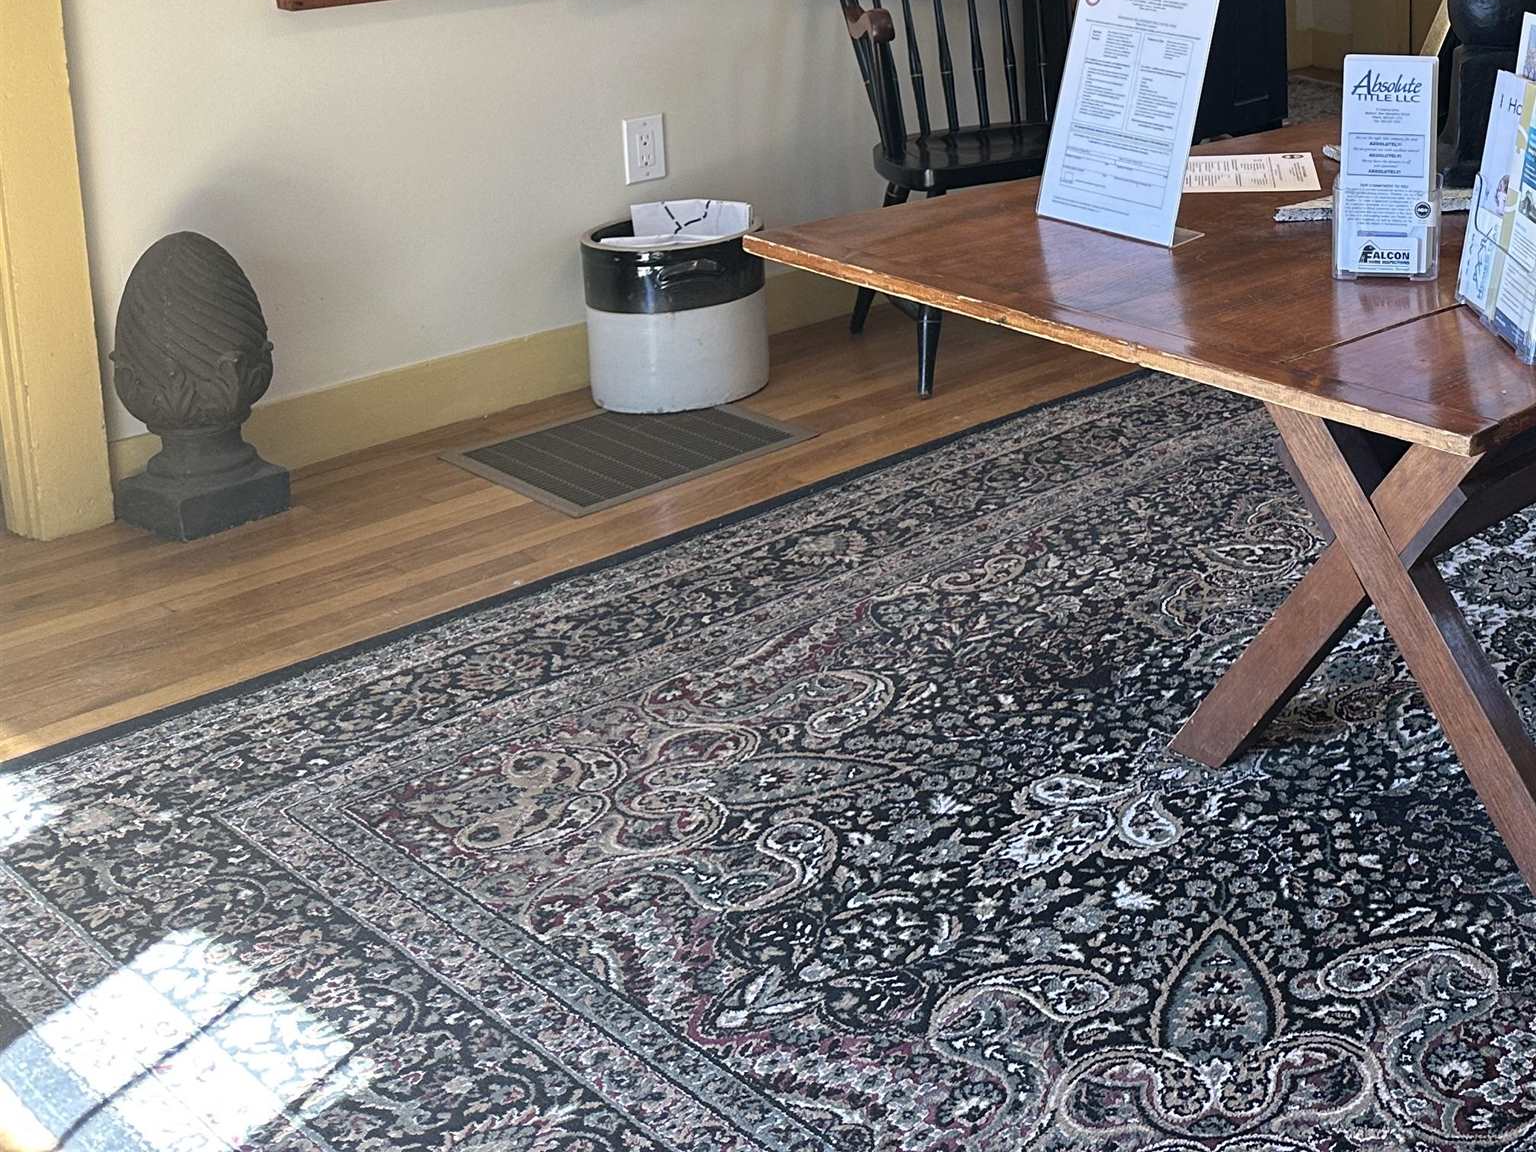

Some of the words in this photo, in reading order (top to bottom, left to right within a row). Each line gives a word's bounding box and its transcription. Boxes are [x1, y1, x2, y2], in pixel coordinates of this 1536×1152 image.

[1351, 69, 1423, 96] Absolute
[1357, 93, 1393, 102] TITLE
[1396, 94, 1421, 103] LLC
[1362, 251, 1410, 264] FALCON
